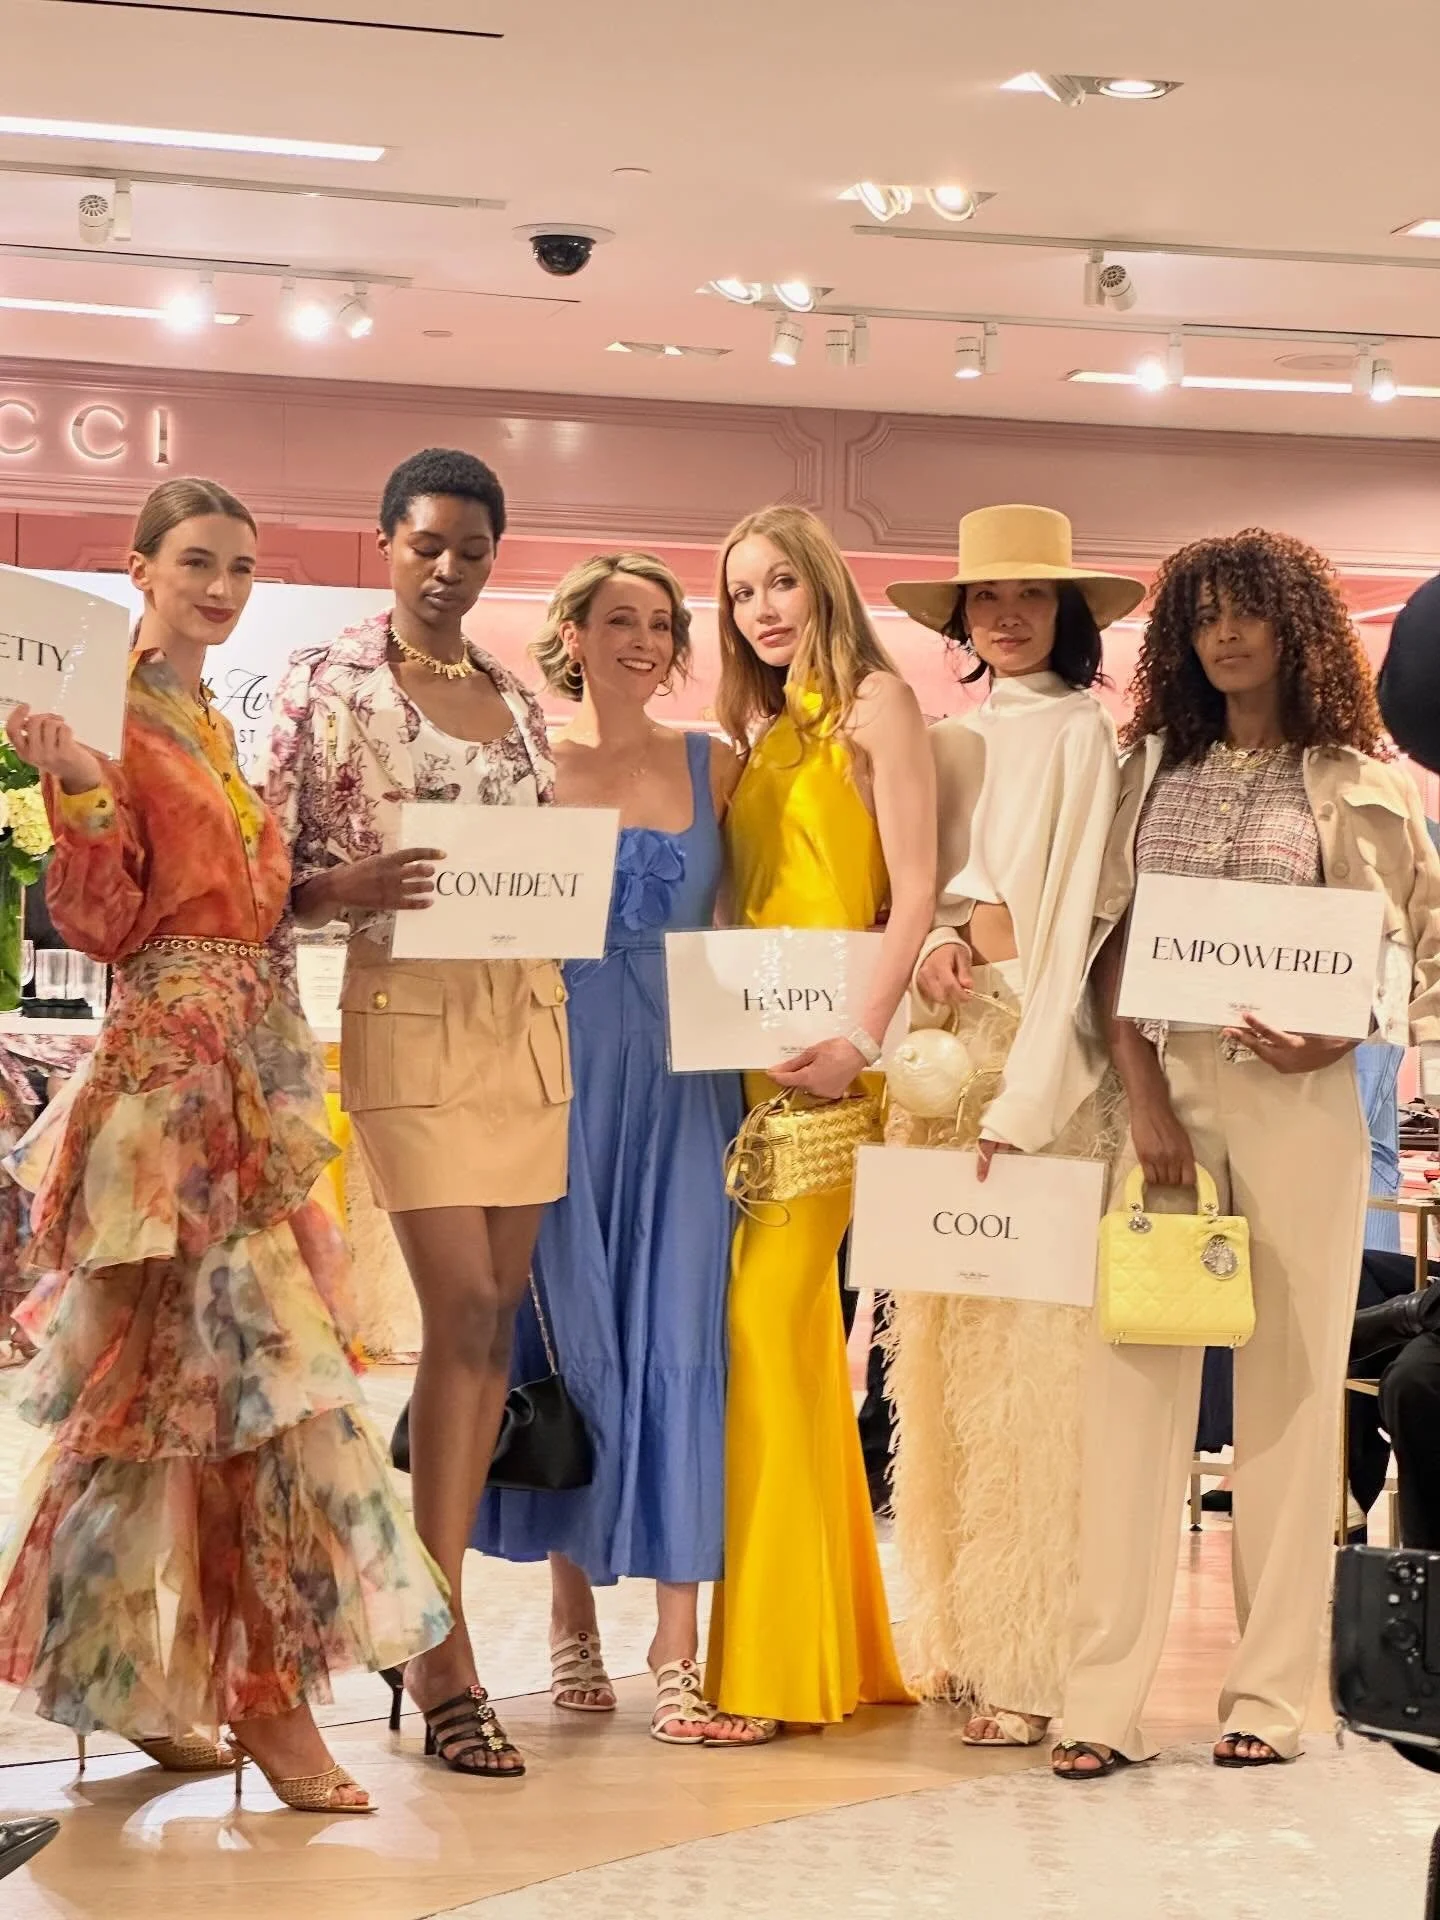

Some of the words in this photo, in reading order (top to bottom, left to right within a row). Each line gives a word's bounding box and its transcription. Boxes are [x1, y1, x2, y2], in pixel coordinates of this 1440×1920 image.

[436, 870, 584, 897] CONFIDENT
[1152, 936, 1353, 975] EMPOWERED
[743, 988, 838, 1012] HAPPY
[933, 1211, 1019, 1240] COOL
